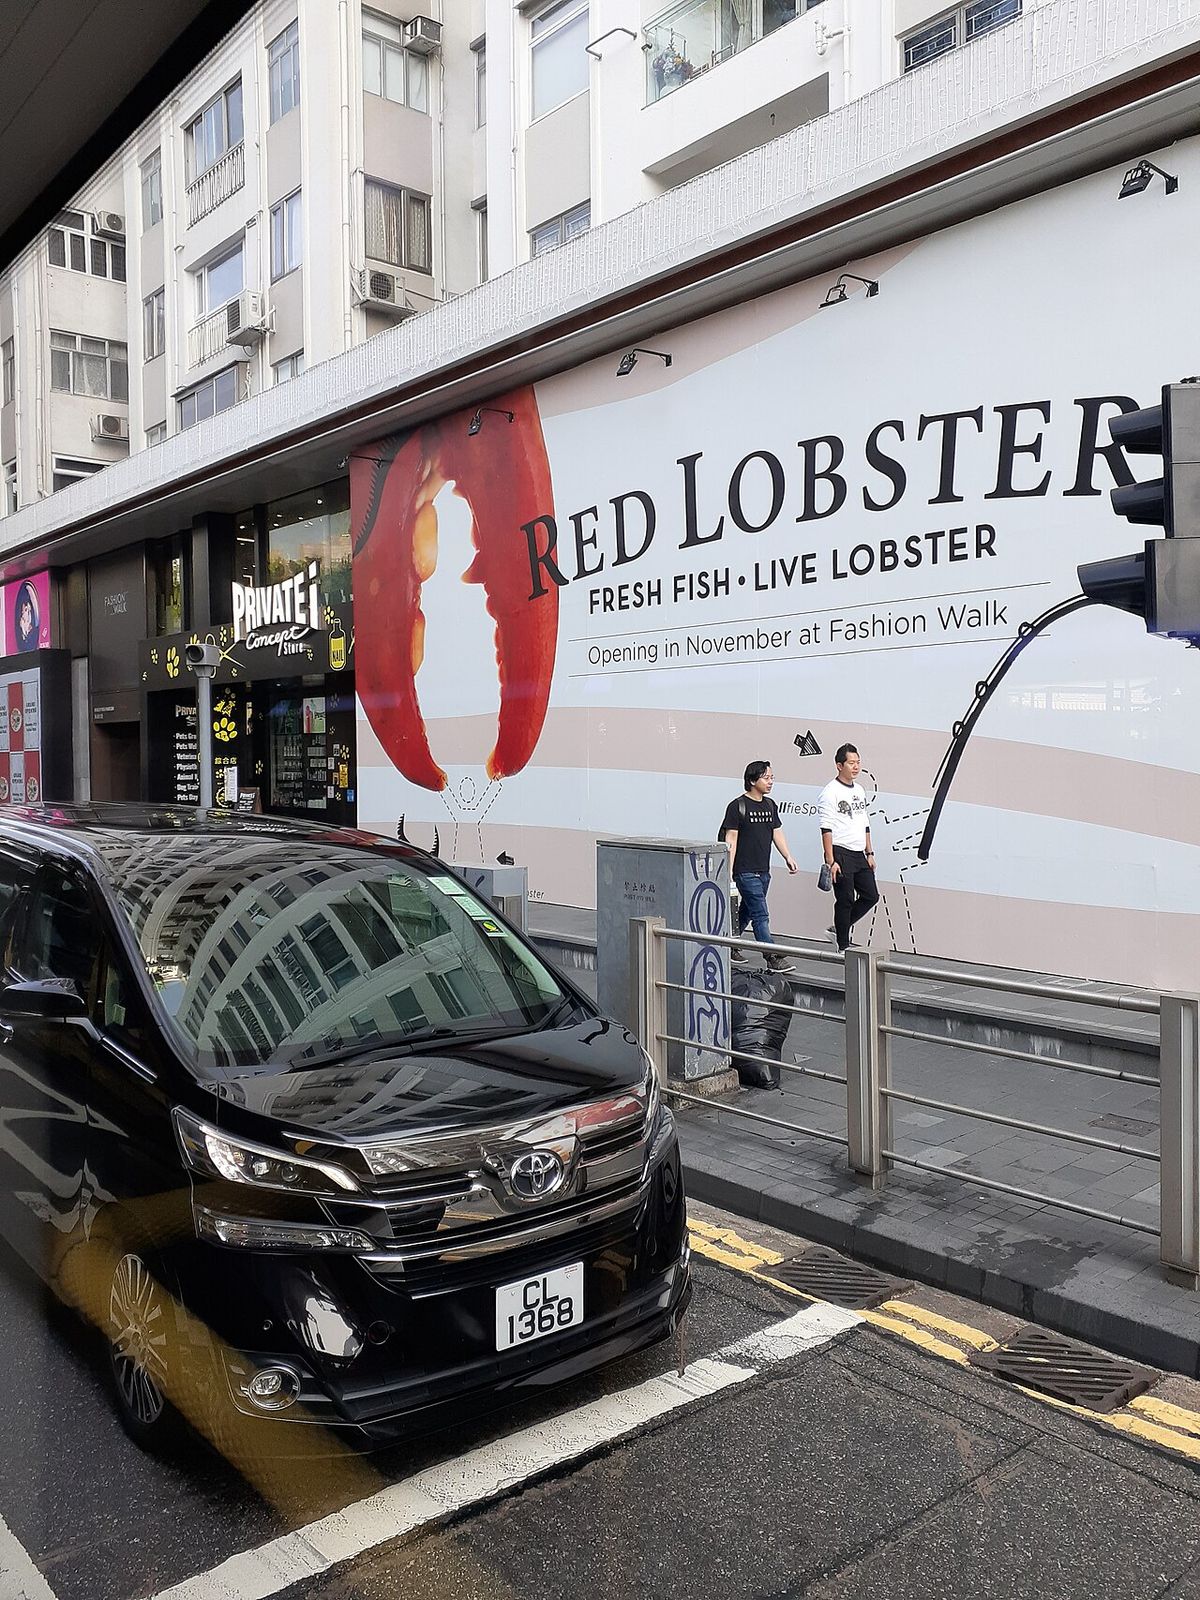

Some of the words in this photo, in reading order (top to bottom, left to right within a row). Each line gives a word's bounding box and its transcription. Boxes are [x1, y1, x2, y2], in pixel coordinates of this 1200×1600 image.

[520, 491, 656, 601] RED
[677, 396, 1140, 549] LOBSTER
[590, 579, 661, 614] FRESH
[673, 568, 730, 603] FISH
[754, 553, 817, 591] LIVE
[832, 524, 997, 579] LOBSTER
[231, 571, 307, 643] PRIVATE
[588, 642, 658, 667] Opening
[665, 639, 680, 658] in
[687, 628, 791, 656] November
[799, 622, 821, 645] at
[830, 612, 926, 642] Fashion
[937, 600, 1008, 630] Walk
[246, 625, 311, 657] Concept
[283, 642, 305, 655] Store
[508, 1297, 574, 1344] 1368
[523, 1277, 560, 1310] CL
